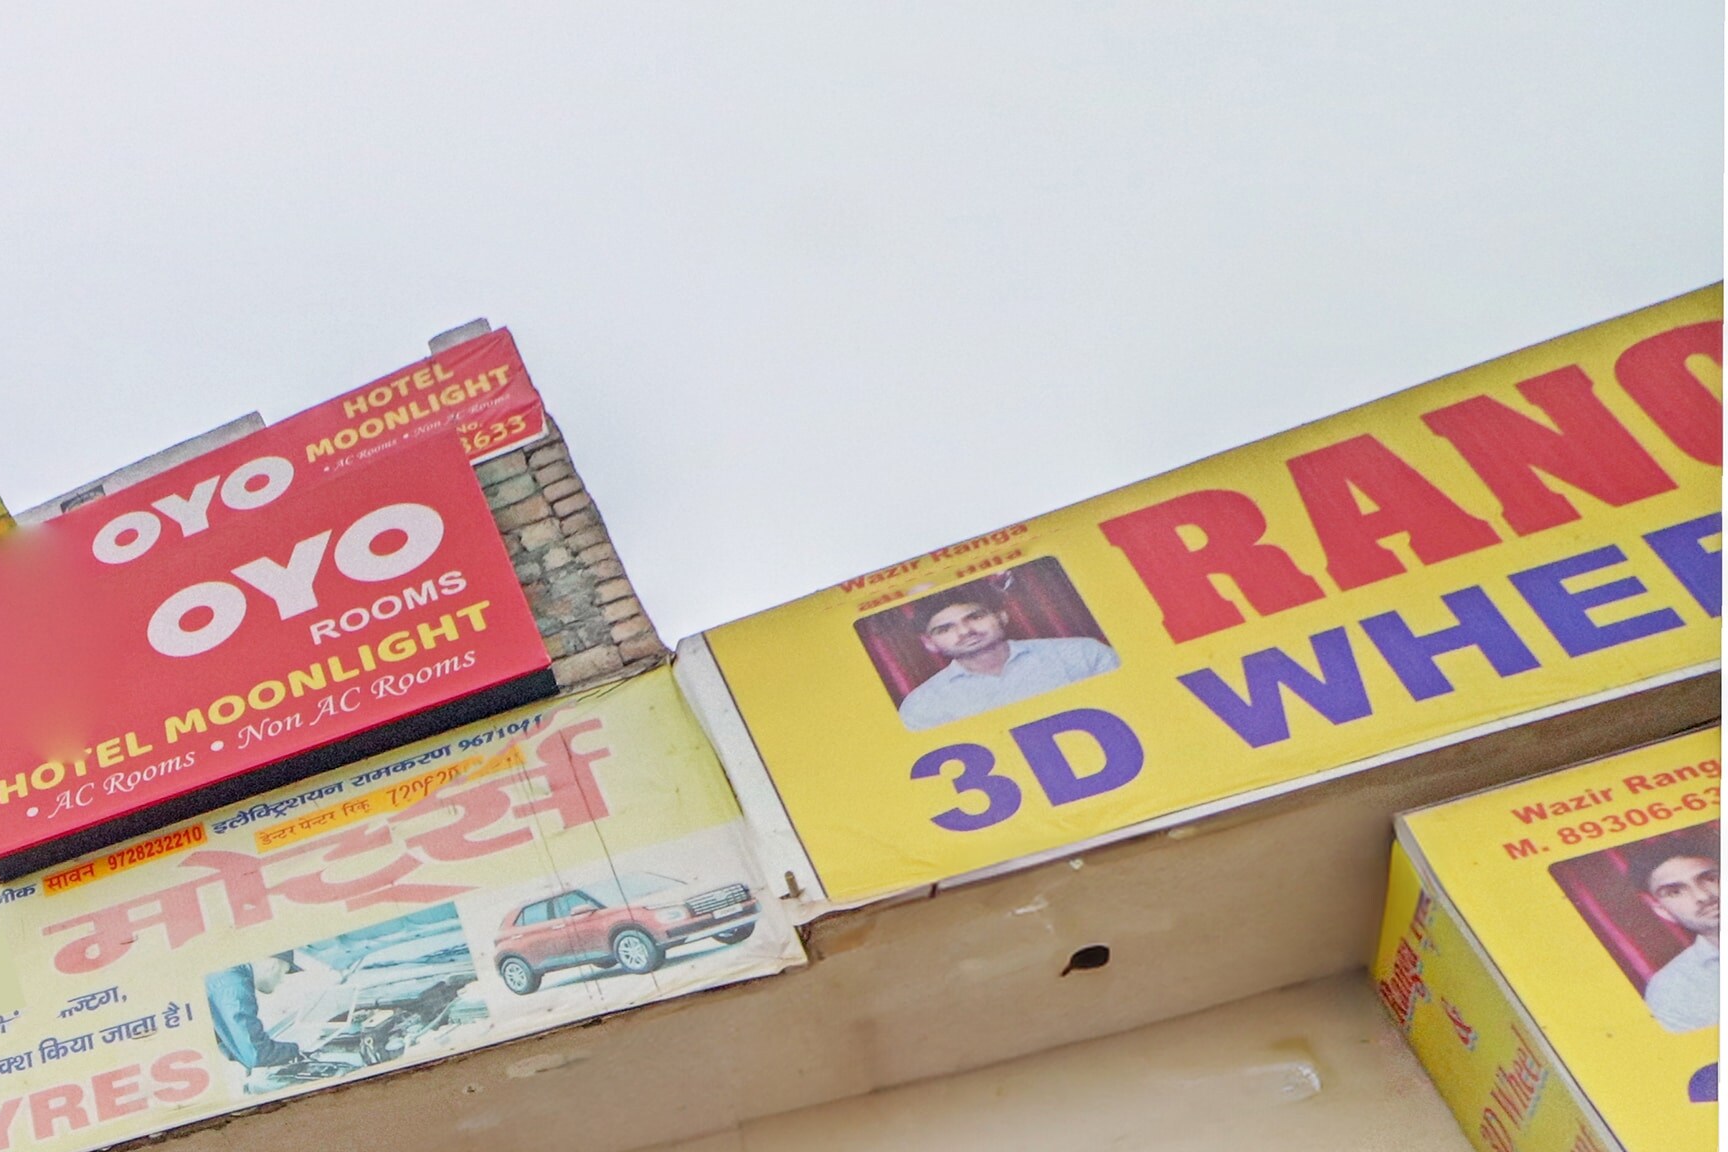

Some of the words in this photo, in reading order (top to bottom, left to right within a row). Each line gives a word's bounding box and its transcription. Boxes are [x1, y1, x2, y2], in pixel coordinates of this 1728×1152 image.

[305, 364, 510, 464] MOONLIGHT
[343, 362, 455, 420] HOTEL
[92, 456, 295, 565] OYO
[146, 503, 445, 658] OYO
[308, 569, 468, 646] ROOMS
[166, 600, 491, 744] MOONLIGHT
[47, 782, 95, 819] AC
[103, 751, 196, 797] Rooms
[237, 712, 303, 750] Non
[314, 687, 362, 727] AC
[370, 650, 477, 700] Rooms
[909, 707, 1145, 832] 3D
[107, 826, 203, 872] 9728232210
[1502, 838, 1550, 861] M.
[1510, 787, 1614, 825] Wazir
[38, 1037, 96, 1065] किया
[99, 1014, 157, 1045] जाता
